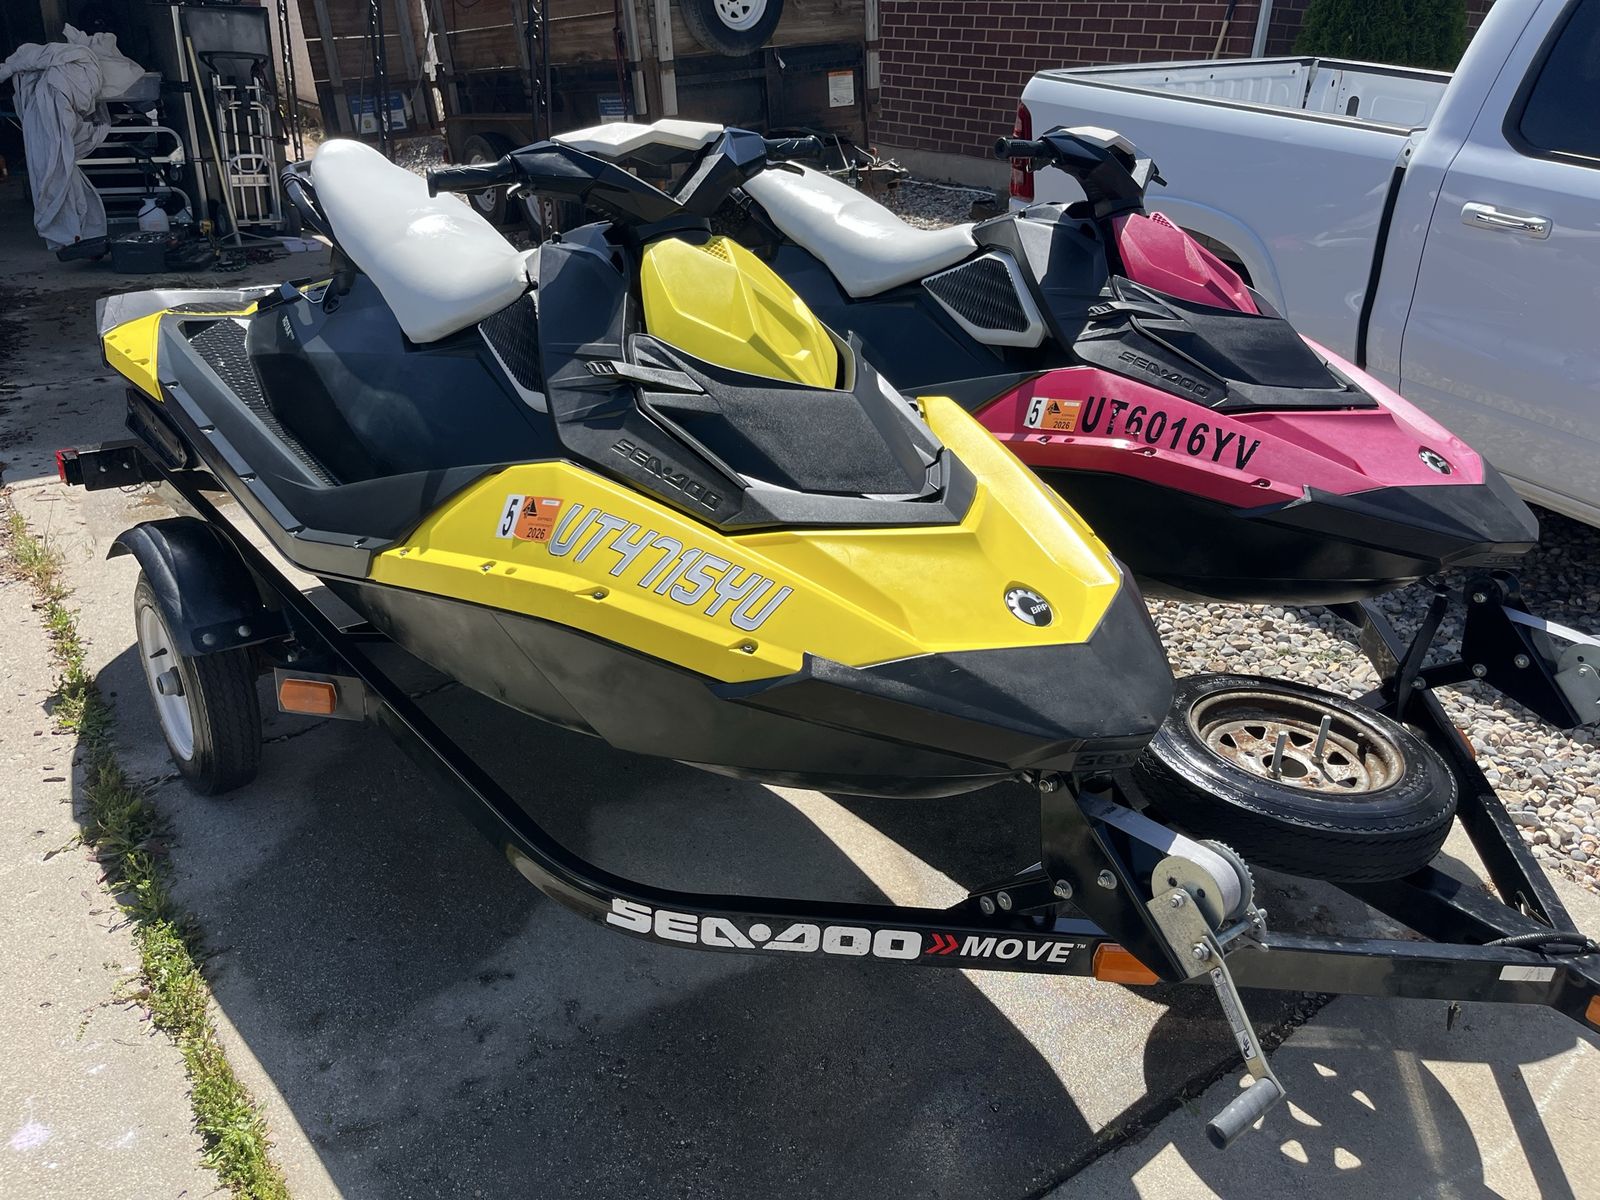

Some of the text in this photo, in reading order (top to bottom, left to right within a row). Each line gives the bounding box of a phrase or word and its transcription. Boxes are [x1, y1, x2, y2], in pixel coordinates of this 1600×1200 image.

[1029, 400, 1042, 425] 5
[1053, 420, 1070, 429] 2026
[1081, 396, 1261, 470] UT6016YV
[502, 498, 519, 536] 5
[526, 527, 546, 539] 2026
[548, 502, 794, 631] UT4715YU
[1030, 603, 1048, 615] BRP
